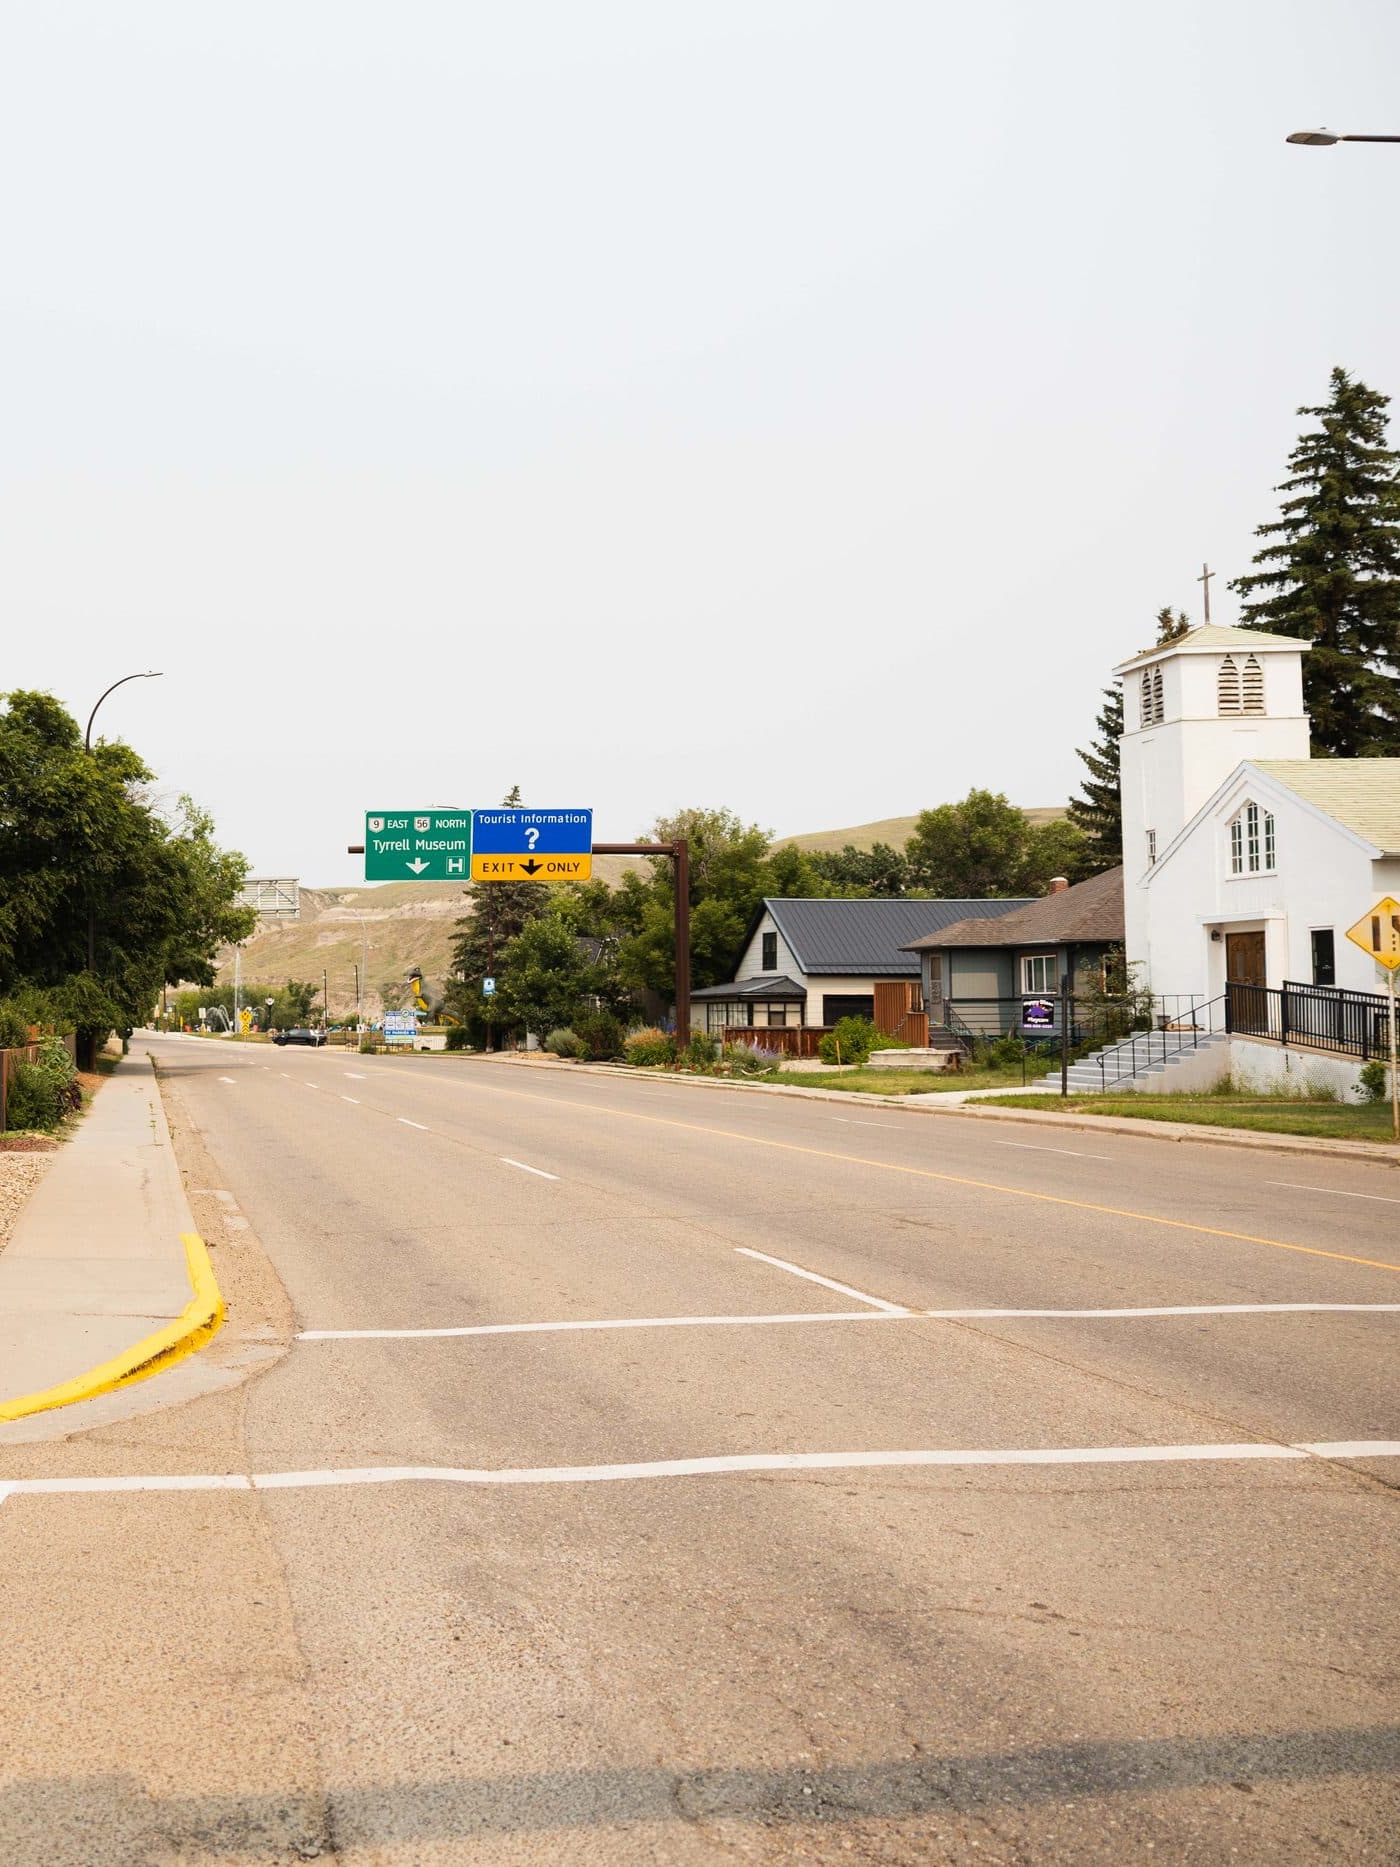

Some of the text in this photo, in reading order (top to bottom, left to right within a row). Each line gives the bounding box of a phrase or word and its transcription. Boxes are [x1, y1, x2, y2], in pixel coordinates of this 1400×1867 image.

[373, 819, 466, 829] 9 EAST 56 NORTH
[479, 813, 587, 824] Tourist Information
[373, 838, 466, 854] Tyrrell Museum
[448, 858, 463, 873] H
[482, 862, 581, 873] EXIT ONLY
